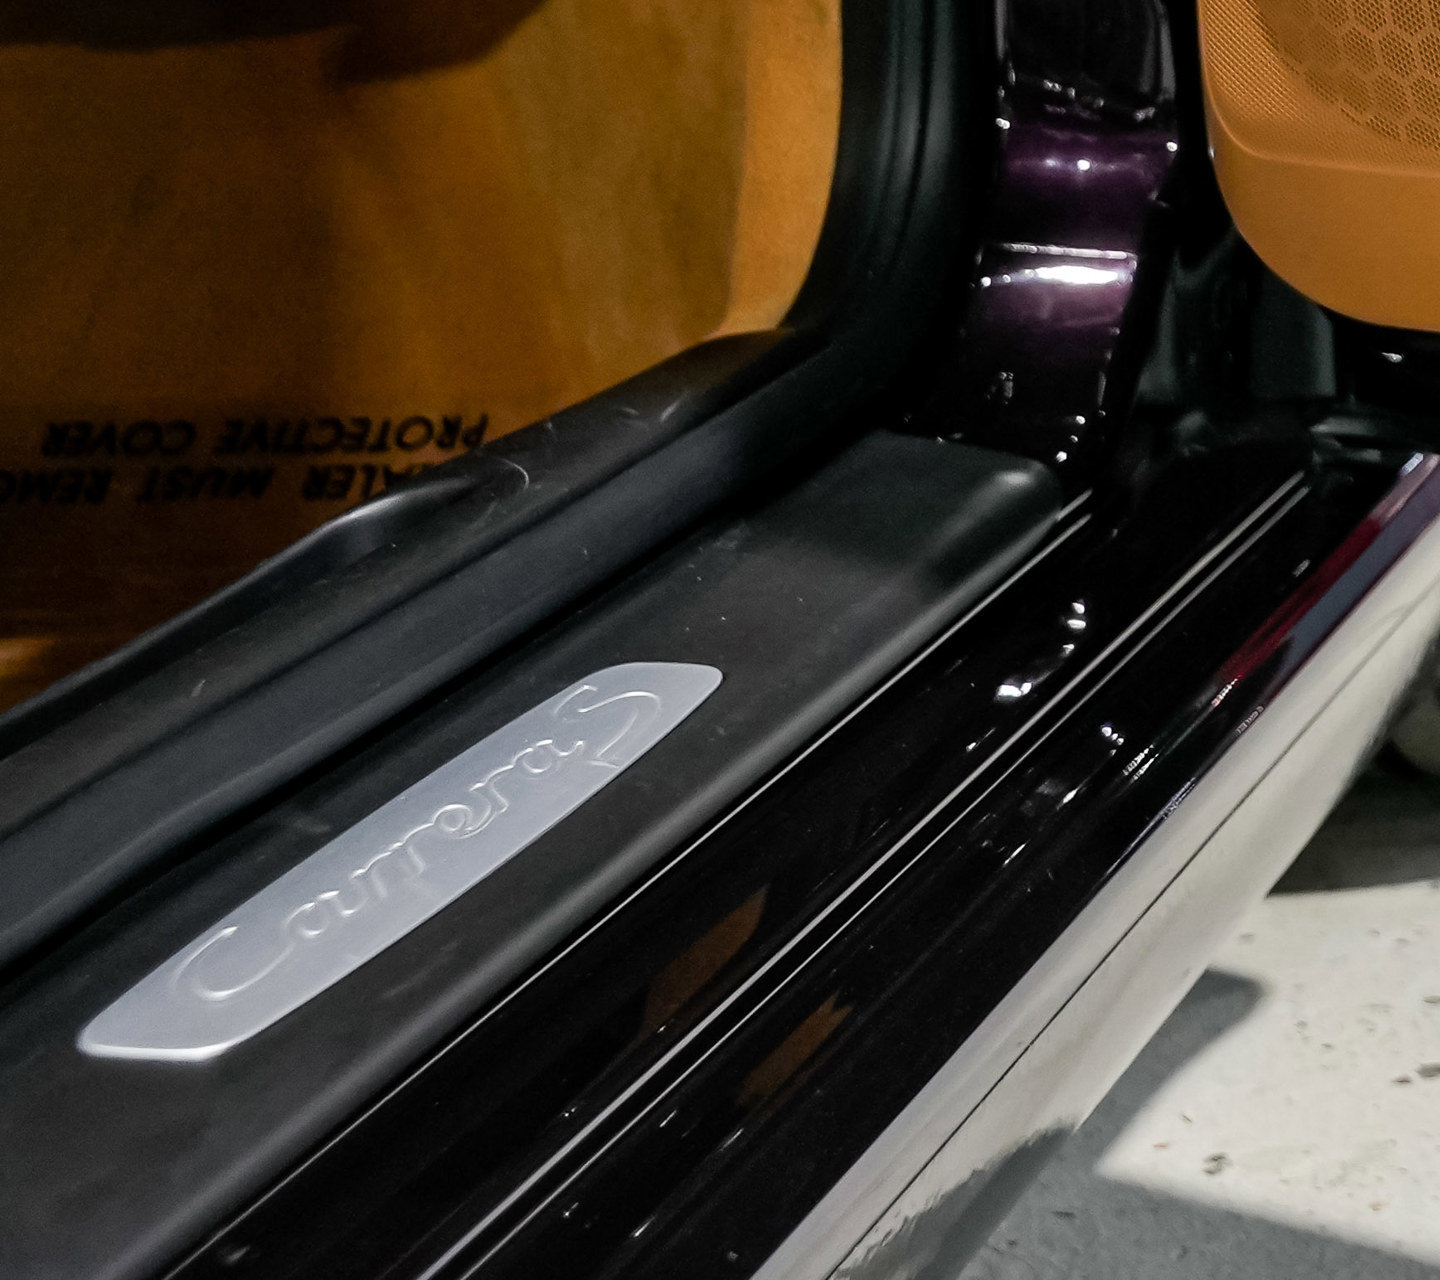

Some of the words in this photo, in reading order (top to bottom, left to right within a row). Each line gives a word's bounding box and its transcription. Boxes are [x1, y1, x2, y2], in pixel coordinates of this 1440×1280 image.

[41, 419, 197, 458] COVER
[214, 414, 488, 456] PROTECTIVE
[138, 466, 277, 504] MUST
[172, 739, 584, 1001] Carrera
